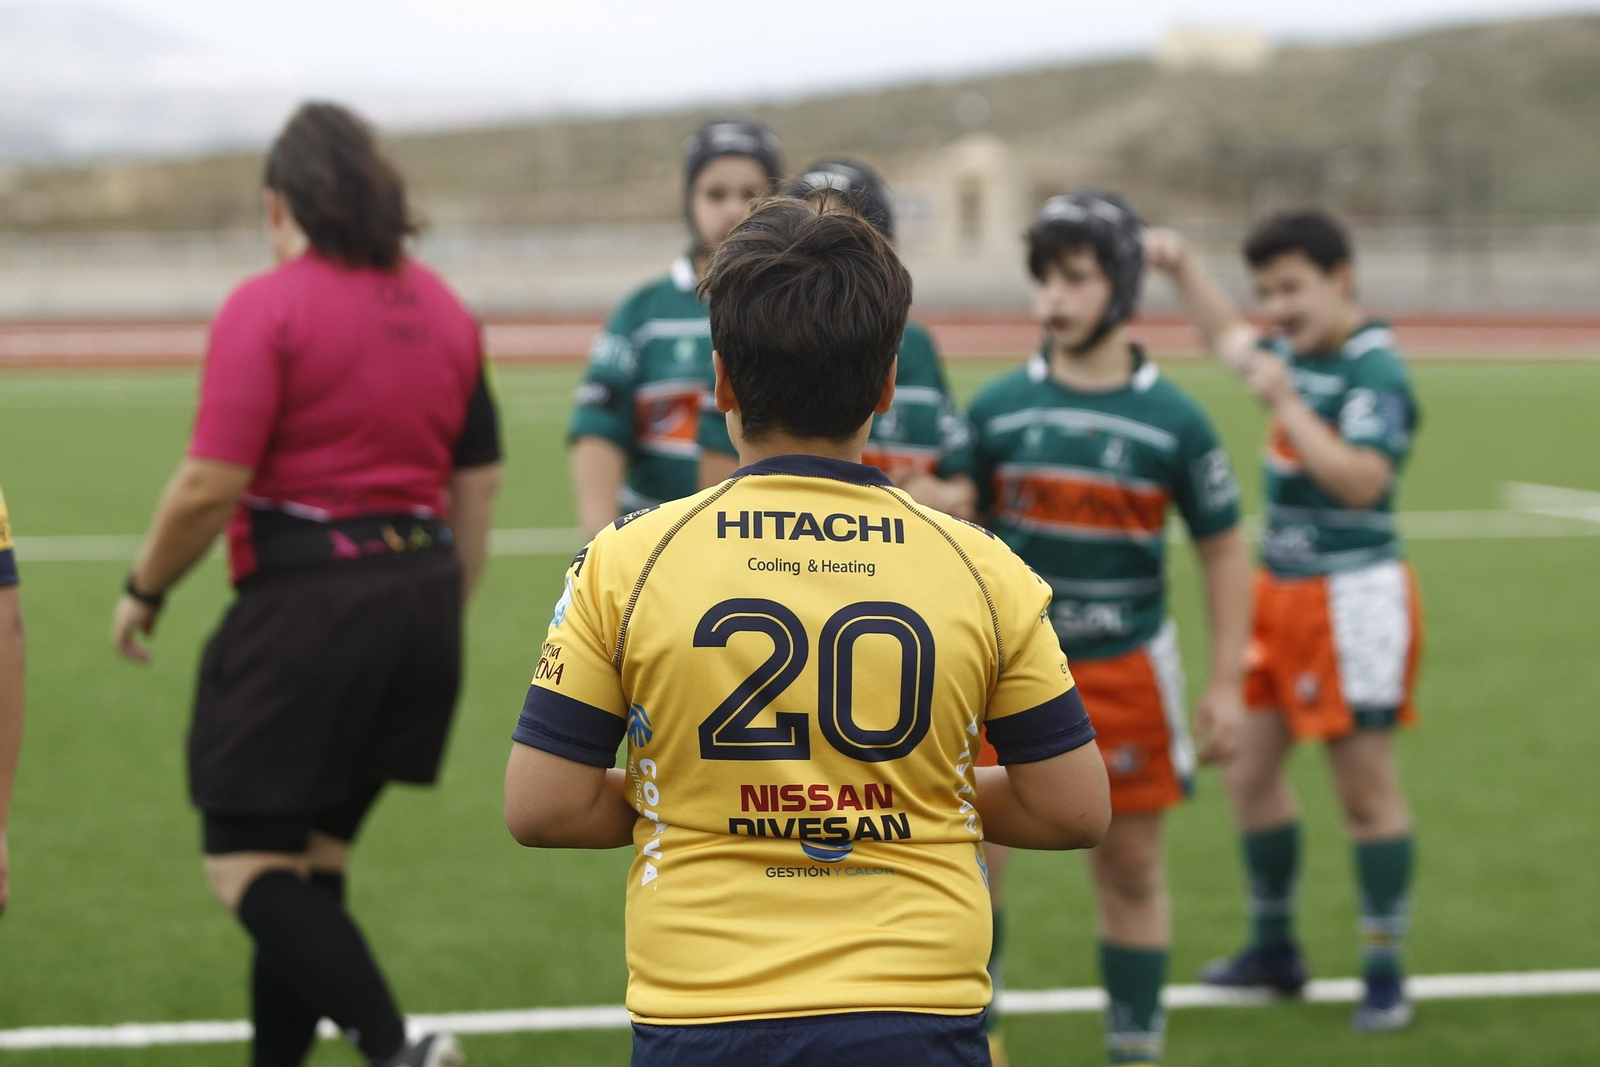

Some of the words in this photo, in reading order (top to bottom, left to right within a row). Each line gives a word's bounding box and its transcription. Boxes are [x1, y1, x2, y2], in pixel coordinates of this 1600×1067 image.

[717, 511, 905, 544] HITACHI
[748, 558, 801, 575] Cooling
[808, 559, 818, 573] &
[822, 560, 876, 577] Heating
[693, 598, 936, 763] 20
[740, 783, 893, 812] NISSAN
[728, 812, 912, 842] DIVESAN
[765, 865, 830, 878] GESTIÓN
[834, 867, 842, 876] Y
[845, 867, 895, 877] CALOR
